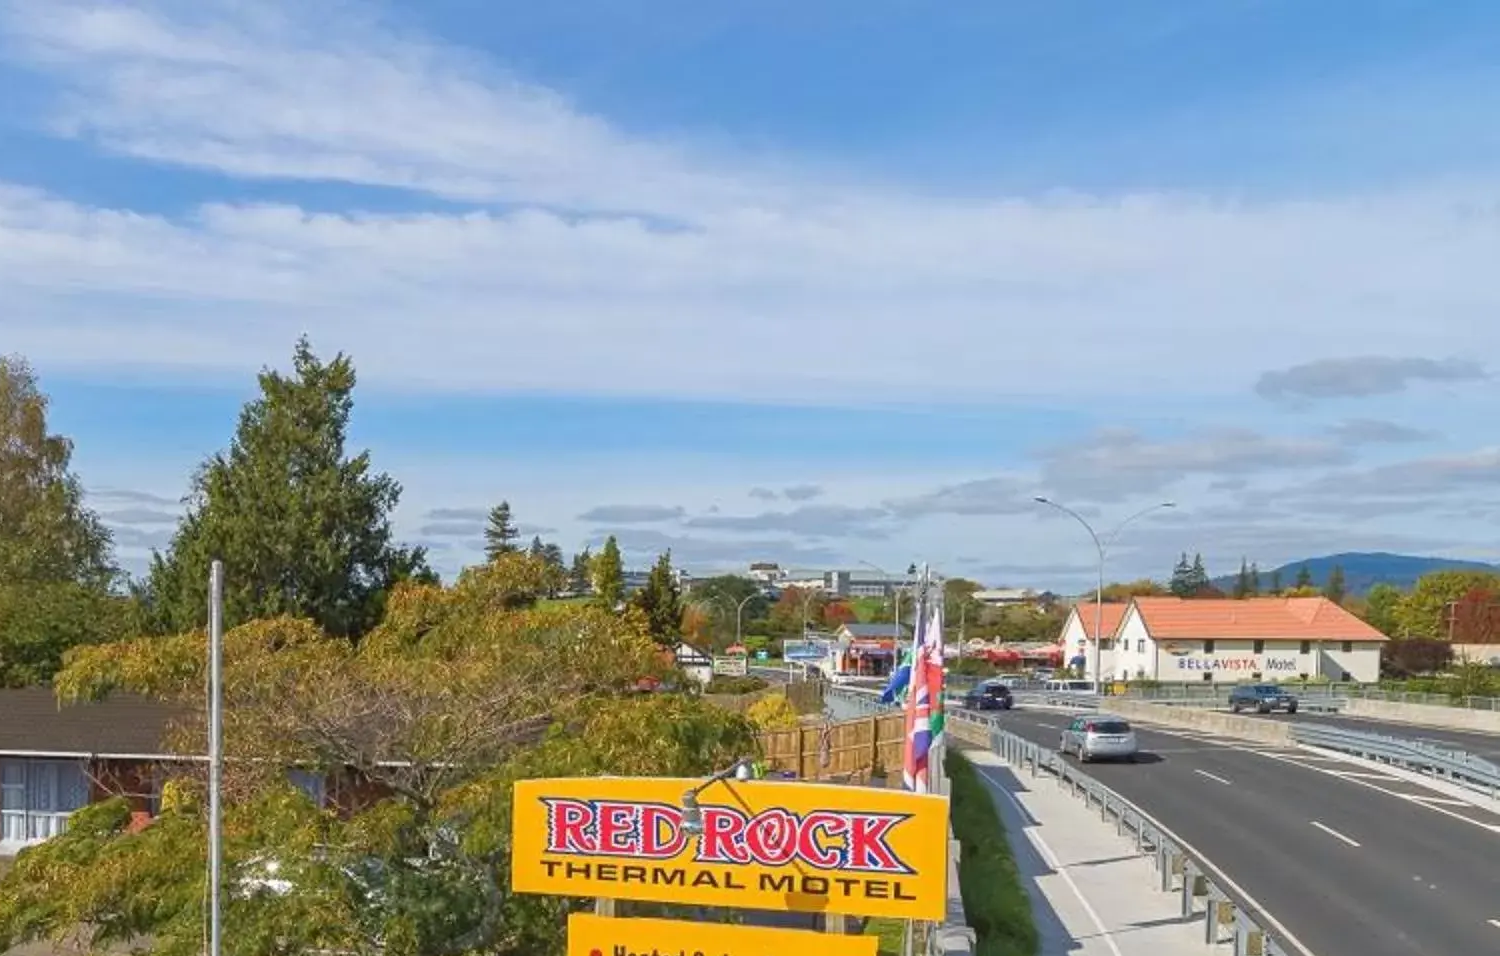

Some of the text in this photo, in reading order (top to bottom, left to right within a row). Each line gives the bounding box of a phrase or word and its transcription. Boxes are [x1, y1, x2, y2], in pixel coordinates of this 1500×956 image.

[1178, 657, 1297, 671] BELLAVISTA Motel
[539, 797, 918, 874] RED ROCK
[540, 860, 918, 901] THERMAL MOTEL
